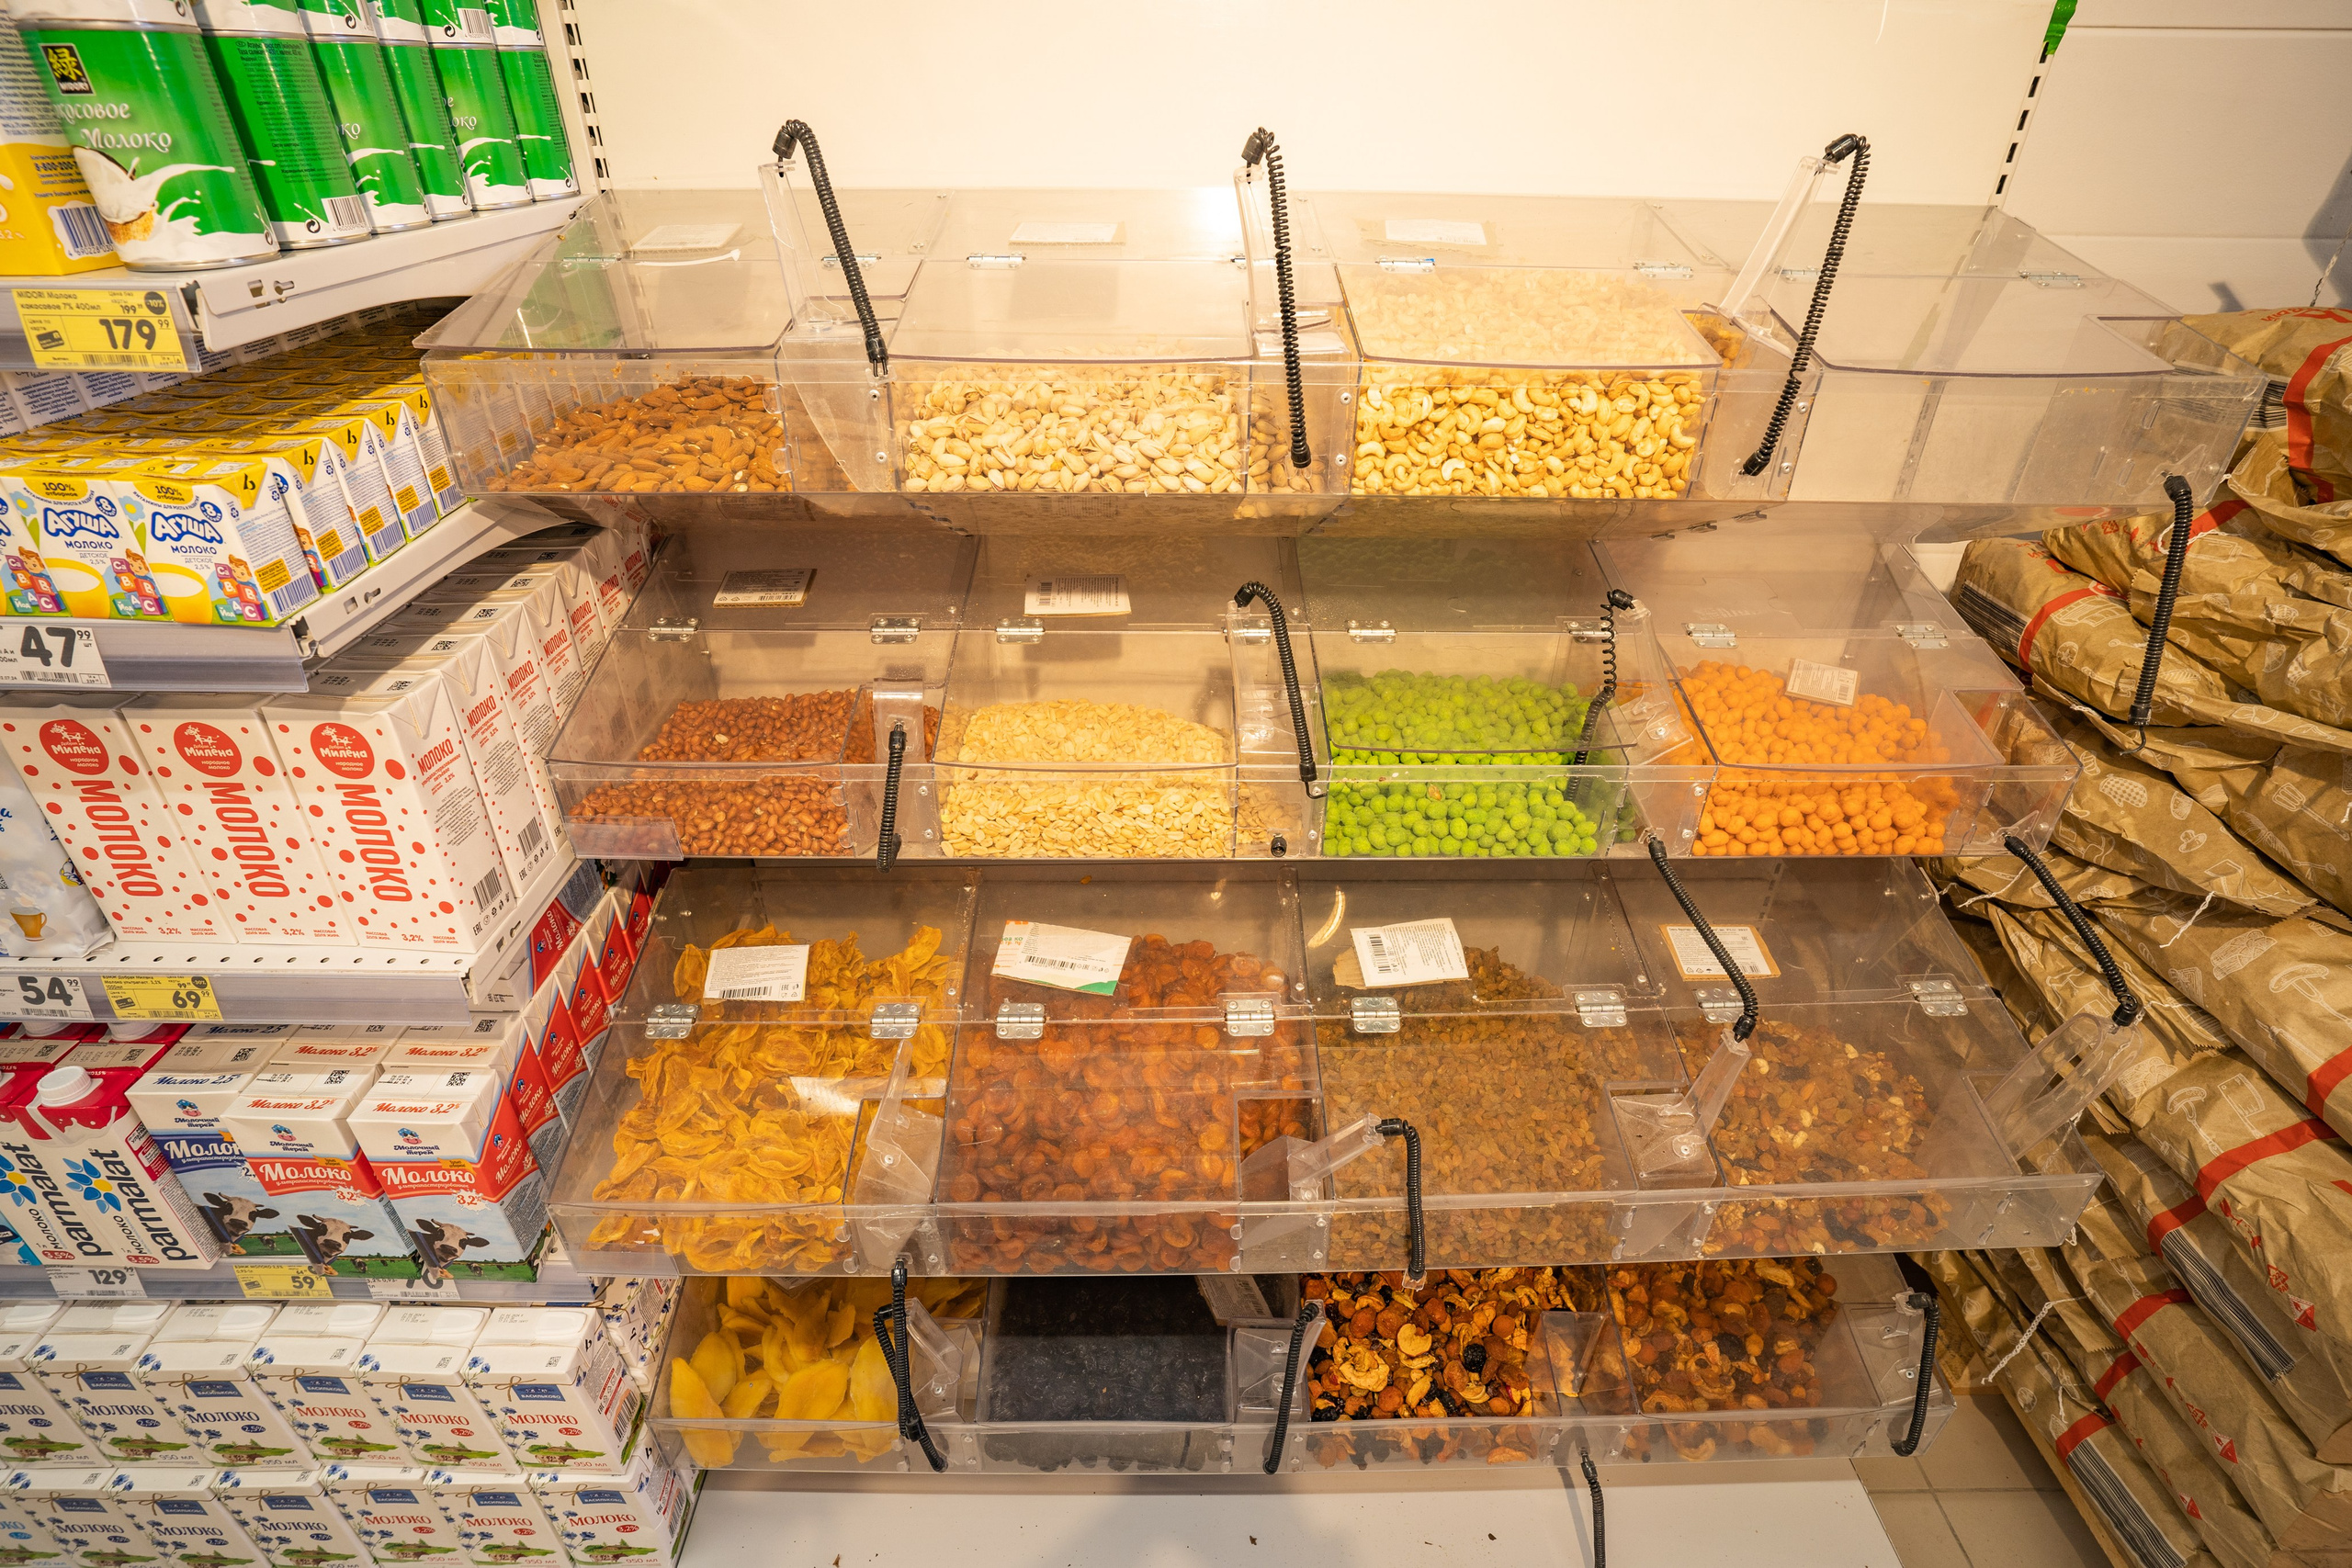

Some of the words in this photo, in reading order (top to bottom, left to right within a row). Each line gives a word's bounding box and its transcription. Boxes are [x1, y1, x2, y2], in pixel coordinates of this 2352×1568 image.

[48, 48, 81, 81] 緑
[59, 82, 89, 93] MIDORI
[81, 129, 172, 152] Молоко
[17, 291, 45, 299] MIDORI
[62, 302, 74, 310] 7%
[75, 303, 101, 311] 400мл
[120, 304, 136, 314] 199
[146, 299, 164, 308] -10%
[98, 318, 156, 351] 179
[157, 319, 169, 328] 99
[42, 482, 75, 492] 100%
[154, 485, 181, 496] 100%
[64, 540, 113, 550] МОЛОКО
[170, 545, 218, 556] МОЛОКО
[599, 574, 620, 601] МОЛОКО
[570, 601, 593, 629] МОЛОКО
[20, 626, 76, 668] 47
[76, 630, 91, 639] 99
[543, 628, 569, 659] МОЛОКО
[507, 660, 535, 693] МОЛОКО
[467, 694, 497, 729] МОЛОКО
[51, 741, 102, 755] Милёна
[184, 745, 234, 758] Милёна
[320, 746, 368, 760] Милёна
[417, 739, 455, 776] МОЛОКО
[71, 780, 164, 897] МОЛОКО
[202, 782, 290, 898] МОЛОКО
[334, 784, 413, 902] МОЛОКО
[519, 866, 528, 881] EAC
[157, 927, 182, 936] 3,2%
[282, 928, 305, 937] 3,2%
[472, 921, 483, 936] EAC
[401, 933, 424, 942] 3,2%
[17, 976, 74, 1007] 54
[172, 989, 201, 1010] 69
[581, 996, 603, 1032] Молоко
[206, 1025, 259, 1034] Молоко
[295, 1045, 348, 1056] Молоко
[349, 1045, 379, 1057] 3,2%
[405, 1046, 459, 1056] Молоко
[460, 1046, 491, 1057] 3,2%
[551, 1039, 574, 1078] Молоко
[153, 1076, 209, 1086] Молоко
[210, 1073, 242, 1086] 2,5%
[247, 1099, 303, 1110] Молоко
[304, 1098, 337, 1110] 3,2%
[372, 1102, 428, 1114] Молоко
[430, 1102, 461, 1114] 3,2%
[519, 1085, 544, 1127] Молоко
[393, 1144, 441, 1153] Молочный
[495, 1139, 523, 1185] Молоко
[258, 1162, 352, 1181] Молоко
[381, 1167, 475, 1186] Молоко
[2, 1143, 115, 1257] parmalat
[336, 1190, 361, 1201] 3,2%
[457, 1194, 481, 1206] 3,2%
[90, 1148, 199, 1261] parmalat
[88, 1269, 127, 1285] 129
[290, 1276, 315, 1290] 59
[82, 1404, 155, 1416] МОЛОКО
[296, 1406, 367, 1419] МОЛОКО
[187, 1411, 261, 1424] МОЛОКО
[401, 1414, 470, 1427] МОЛОКО
[507, 1414, 579, 1427] МОЛОКО
[260, 1521, 328, 1532] МОЛОКО
[364, 1515, 432, 1527] МОЛОКО
[465, 1515, 533, 1528] МОЛОКО
[568, 1514, 637, 1528] МОЛОКО
[56, 1523, 125, 1534] МОЛОКО
[154, 1526, 223, 1537] МОЛОКО
[616, 1524, 639, 1533] 3,2%
